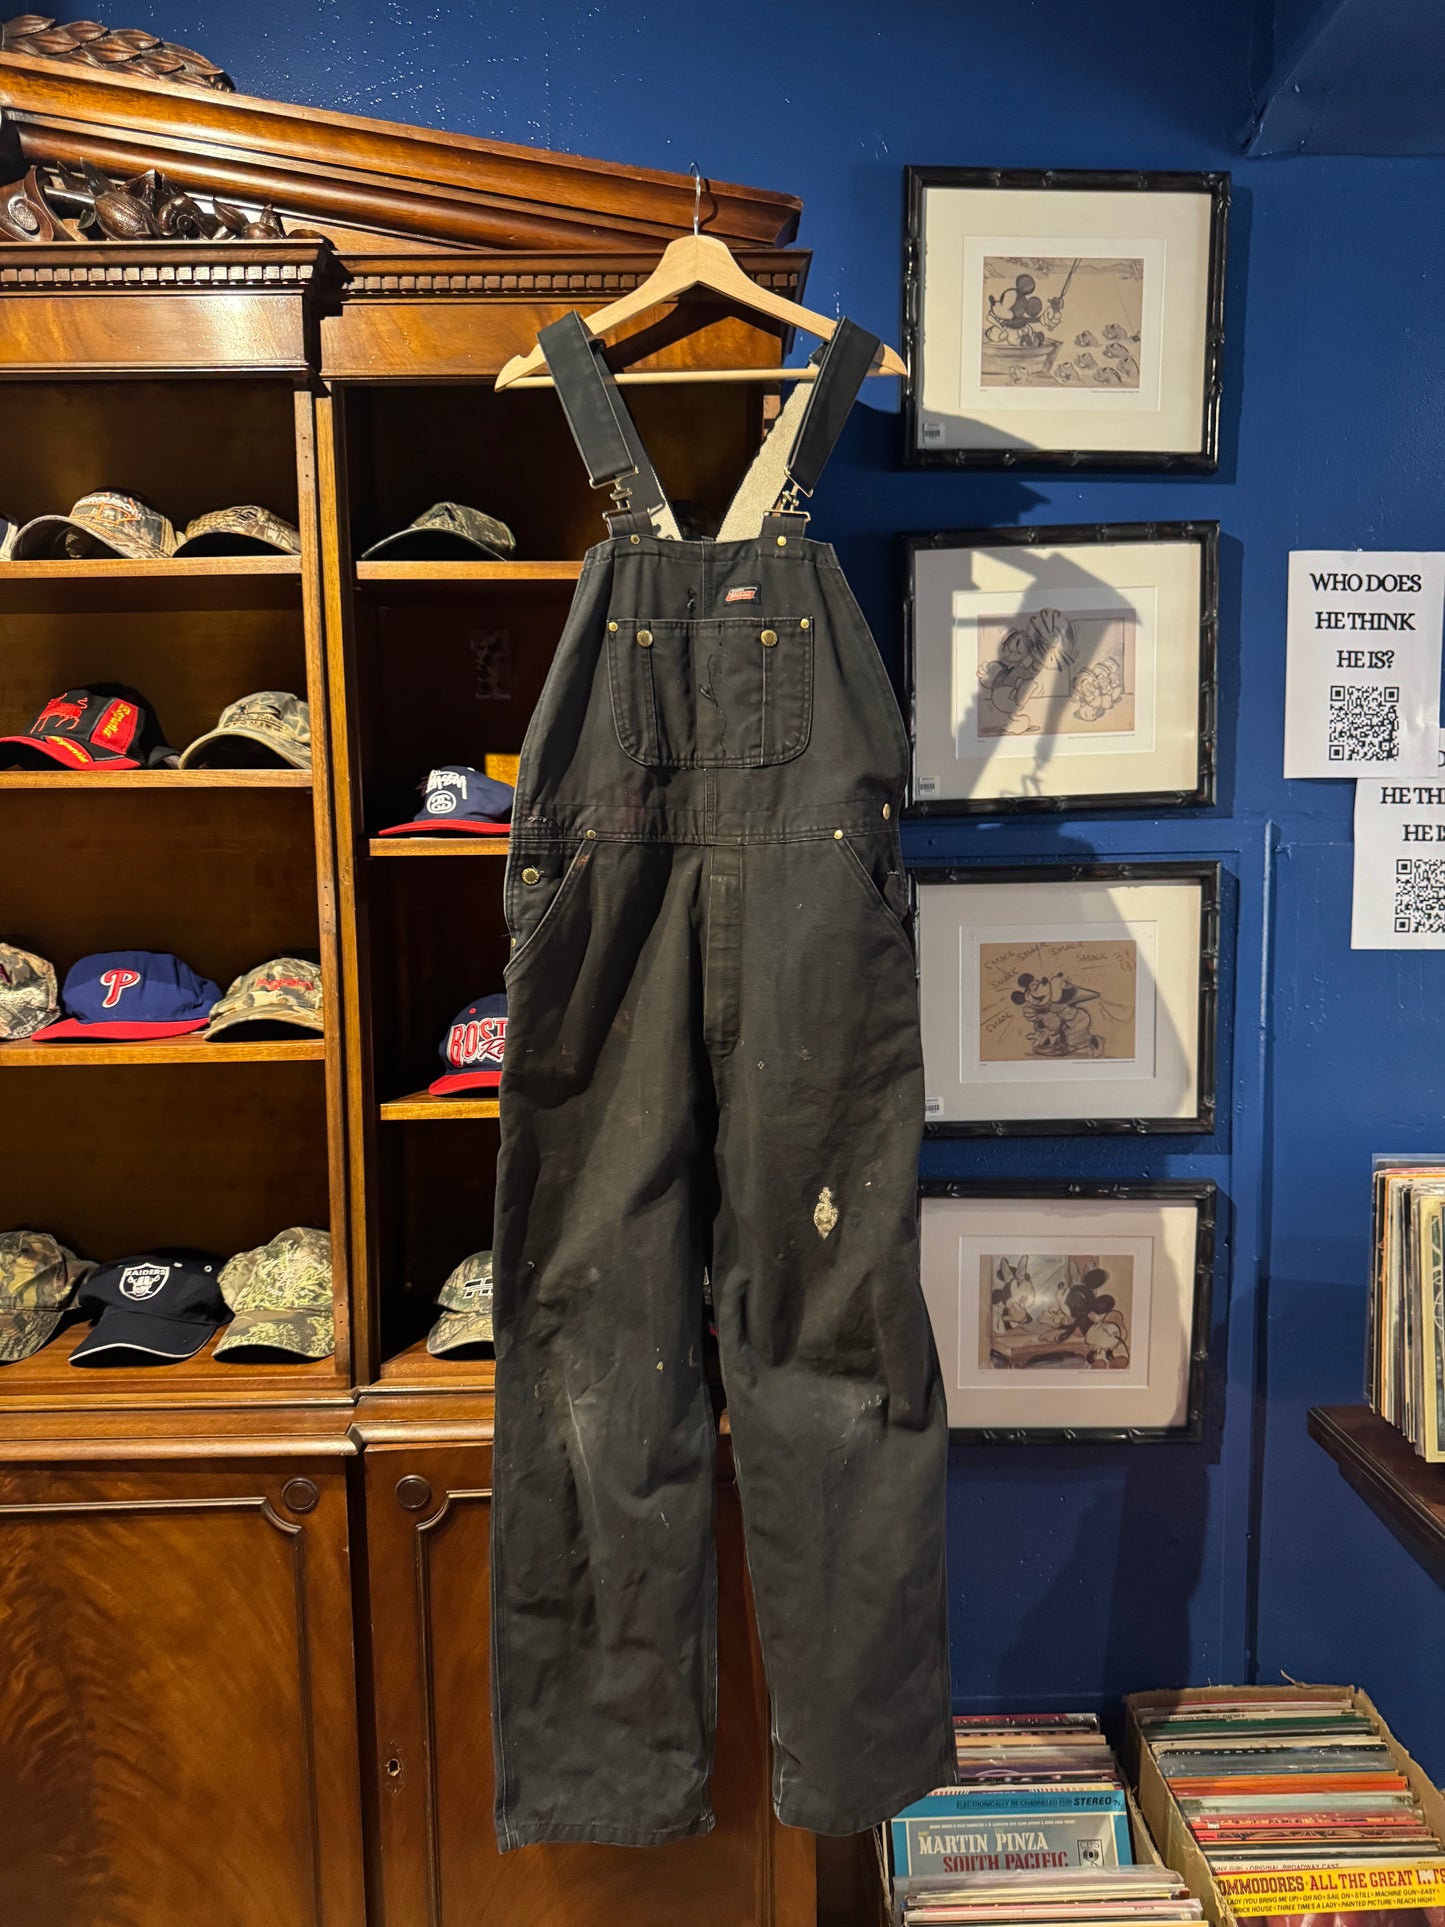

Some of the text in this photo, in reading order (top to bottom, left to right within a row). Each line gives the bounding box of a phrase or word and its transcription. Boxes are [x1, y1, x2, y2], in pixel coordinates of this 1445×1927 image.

[1309, 573, 1422, 592] WHO DOES
[1315, 611, 1416, 631] HE THINK
[1336, 650, 1395, 669] HE IS?
[1380, 787, 1445, 804] HE TH
[1402, 824, 1433, 841] HE
[100, 968, 141, 1008] P
[446, 1017, 509, 1069] BOST
[478, 1036, 505, 1062] Re
[1073, 1796, 1112, 1806] STEREO
[918, 1831, 1049, 1855] MARTIN PINZA
[943, 1851, 1069, 1873] SOUTH PACIFIC
[1217, 1874, 1305, 1897] OMMODORES
[1309, 1873, 1338, 1891] ALL
[1338, 1872, 1368, 1889] THE
[1369, 1869, 1413, 1888] GREAT
